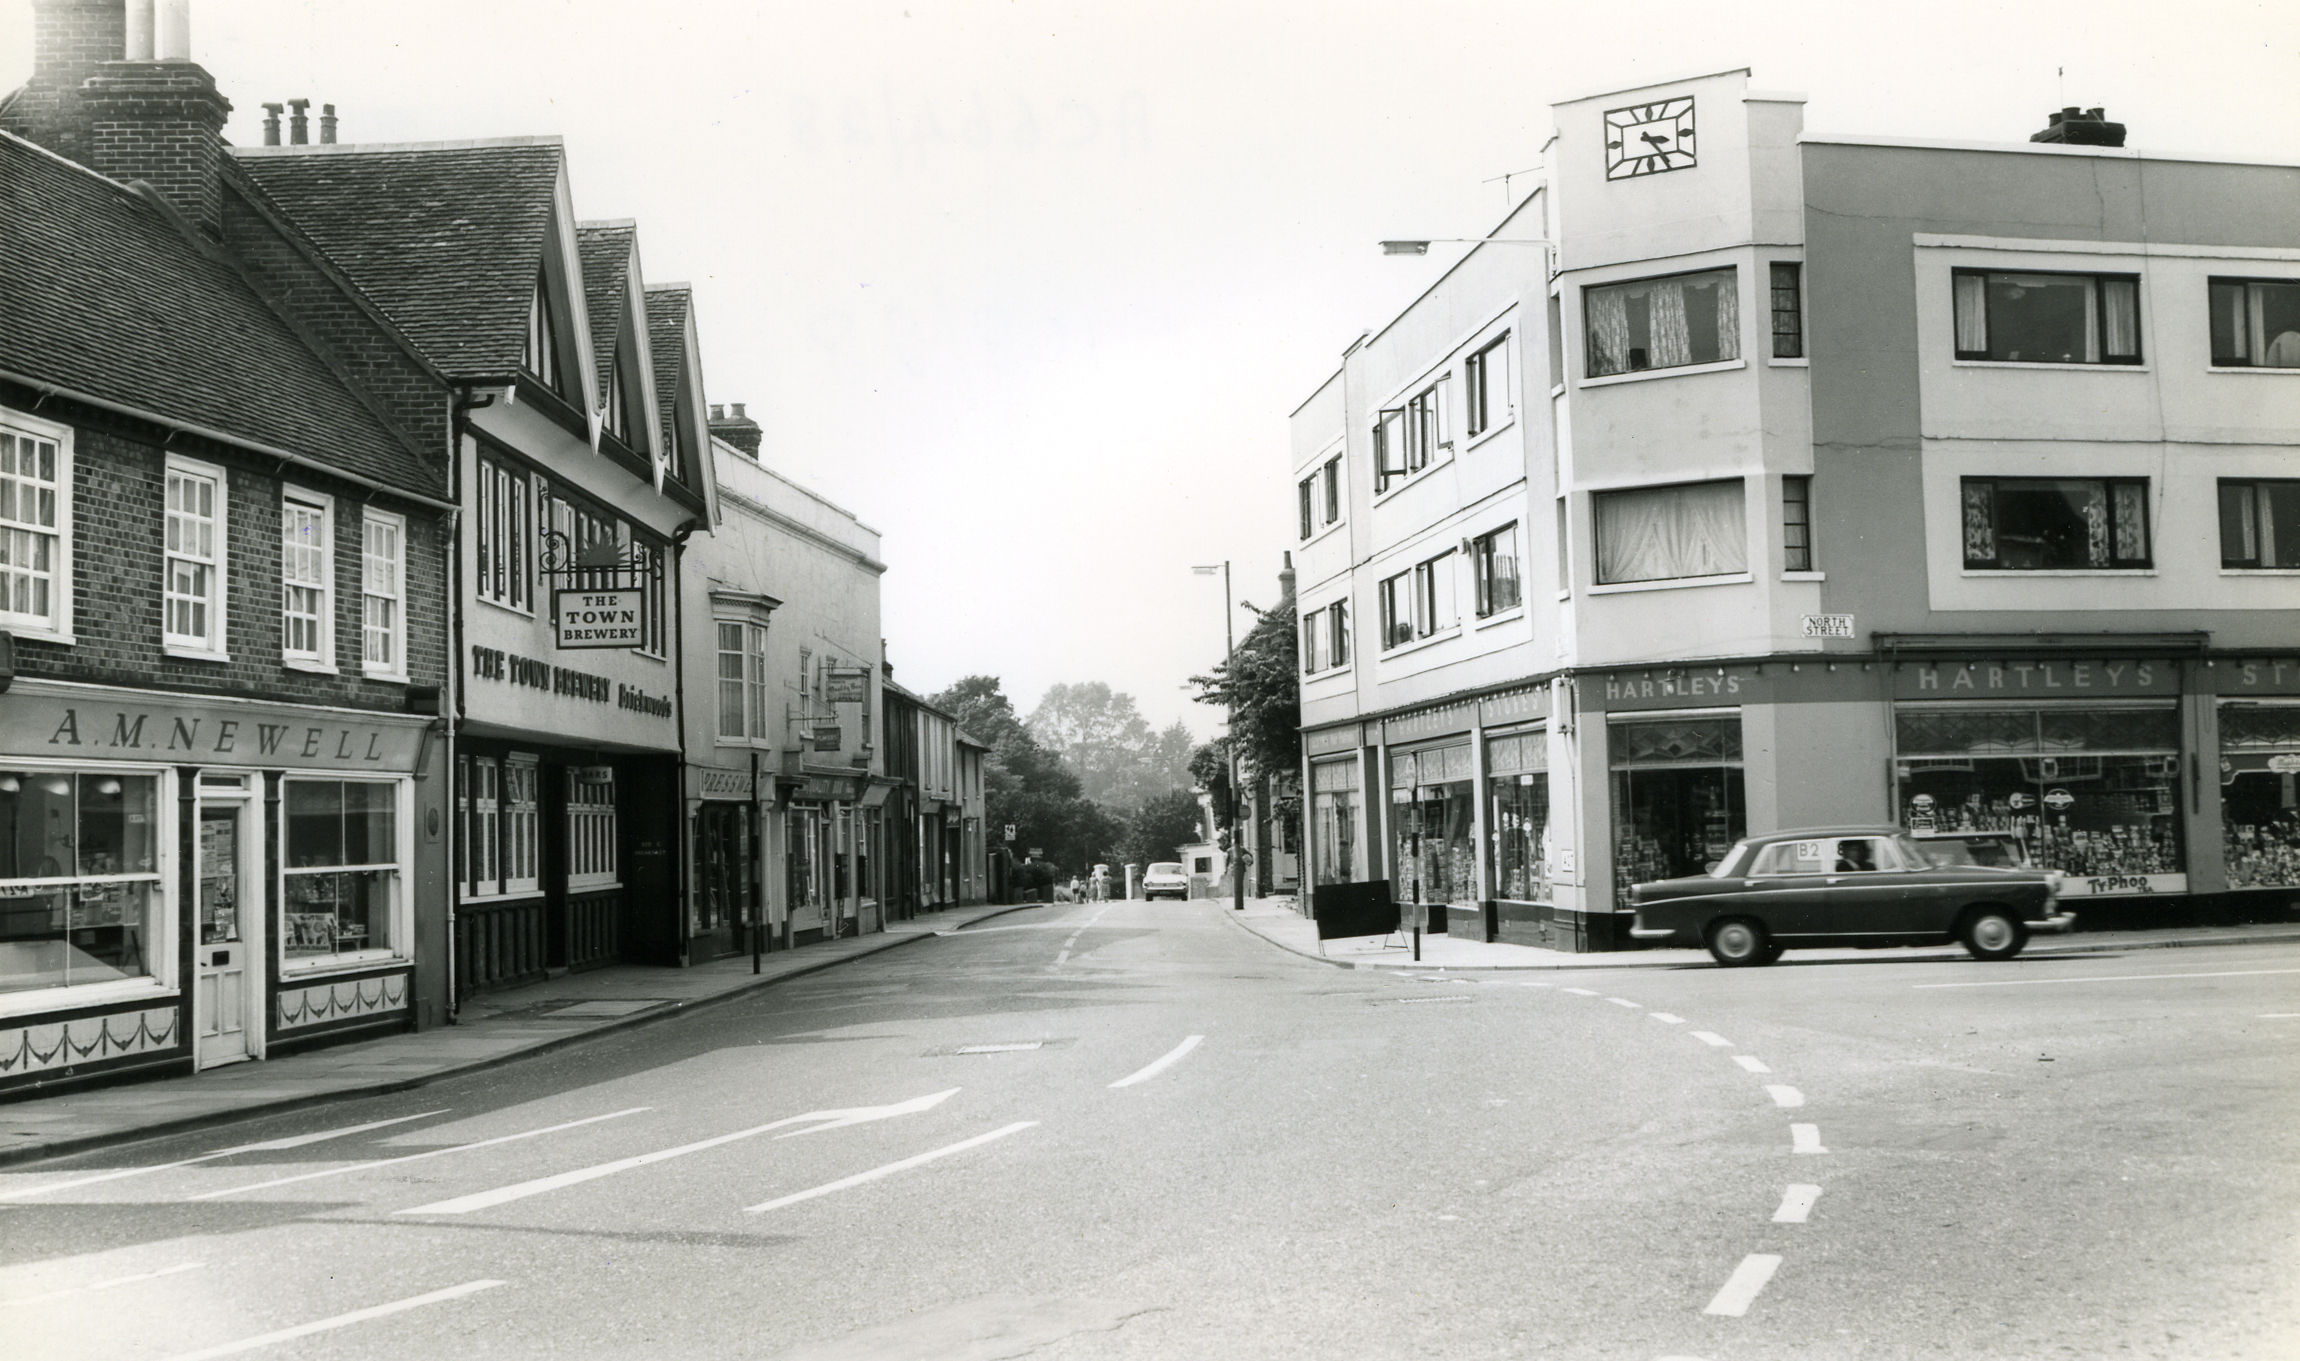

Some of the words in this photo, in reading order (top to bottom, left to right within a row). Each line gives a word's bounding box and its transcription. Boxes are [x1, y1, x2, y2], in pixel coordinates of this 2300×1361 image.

[582, 595, 618, 607] THE
[566, 610, 635, 625] TOWN
[1809, 617, 1846, 627] NORTH
[564, 628, 638, 641] BREWERY
[1806, 626, 1848, 636] STREET
[472, 645, 505, 681] THE
[509, 654, 551, 691] TOWN
[553, 666, 610, 703] BREWERY
[1605, 676, 1740, 700] HARTLEYS
[1919, 664, 2153, 689] HARTLEYS
[2242, 662, 2300, 685] ST
